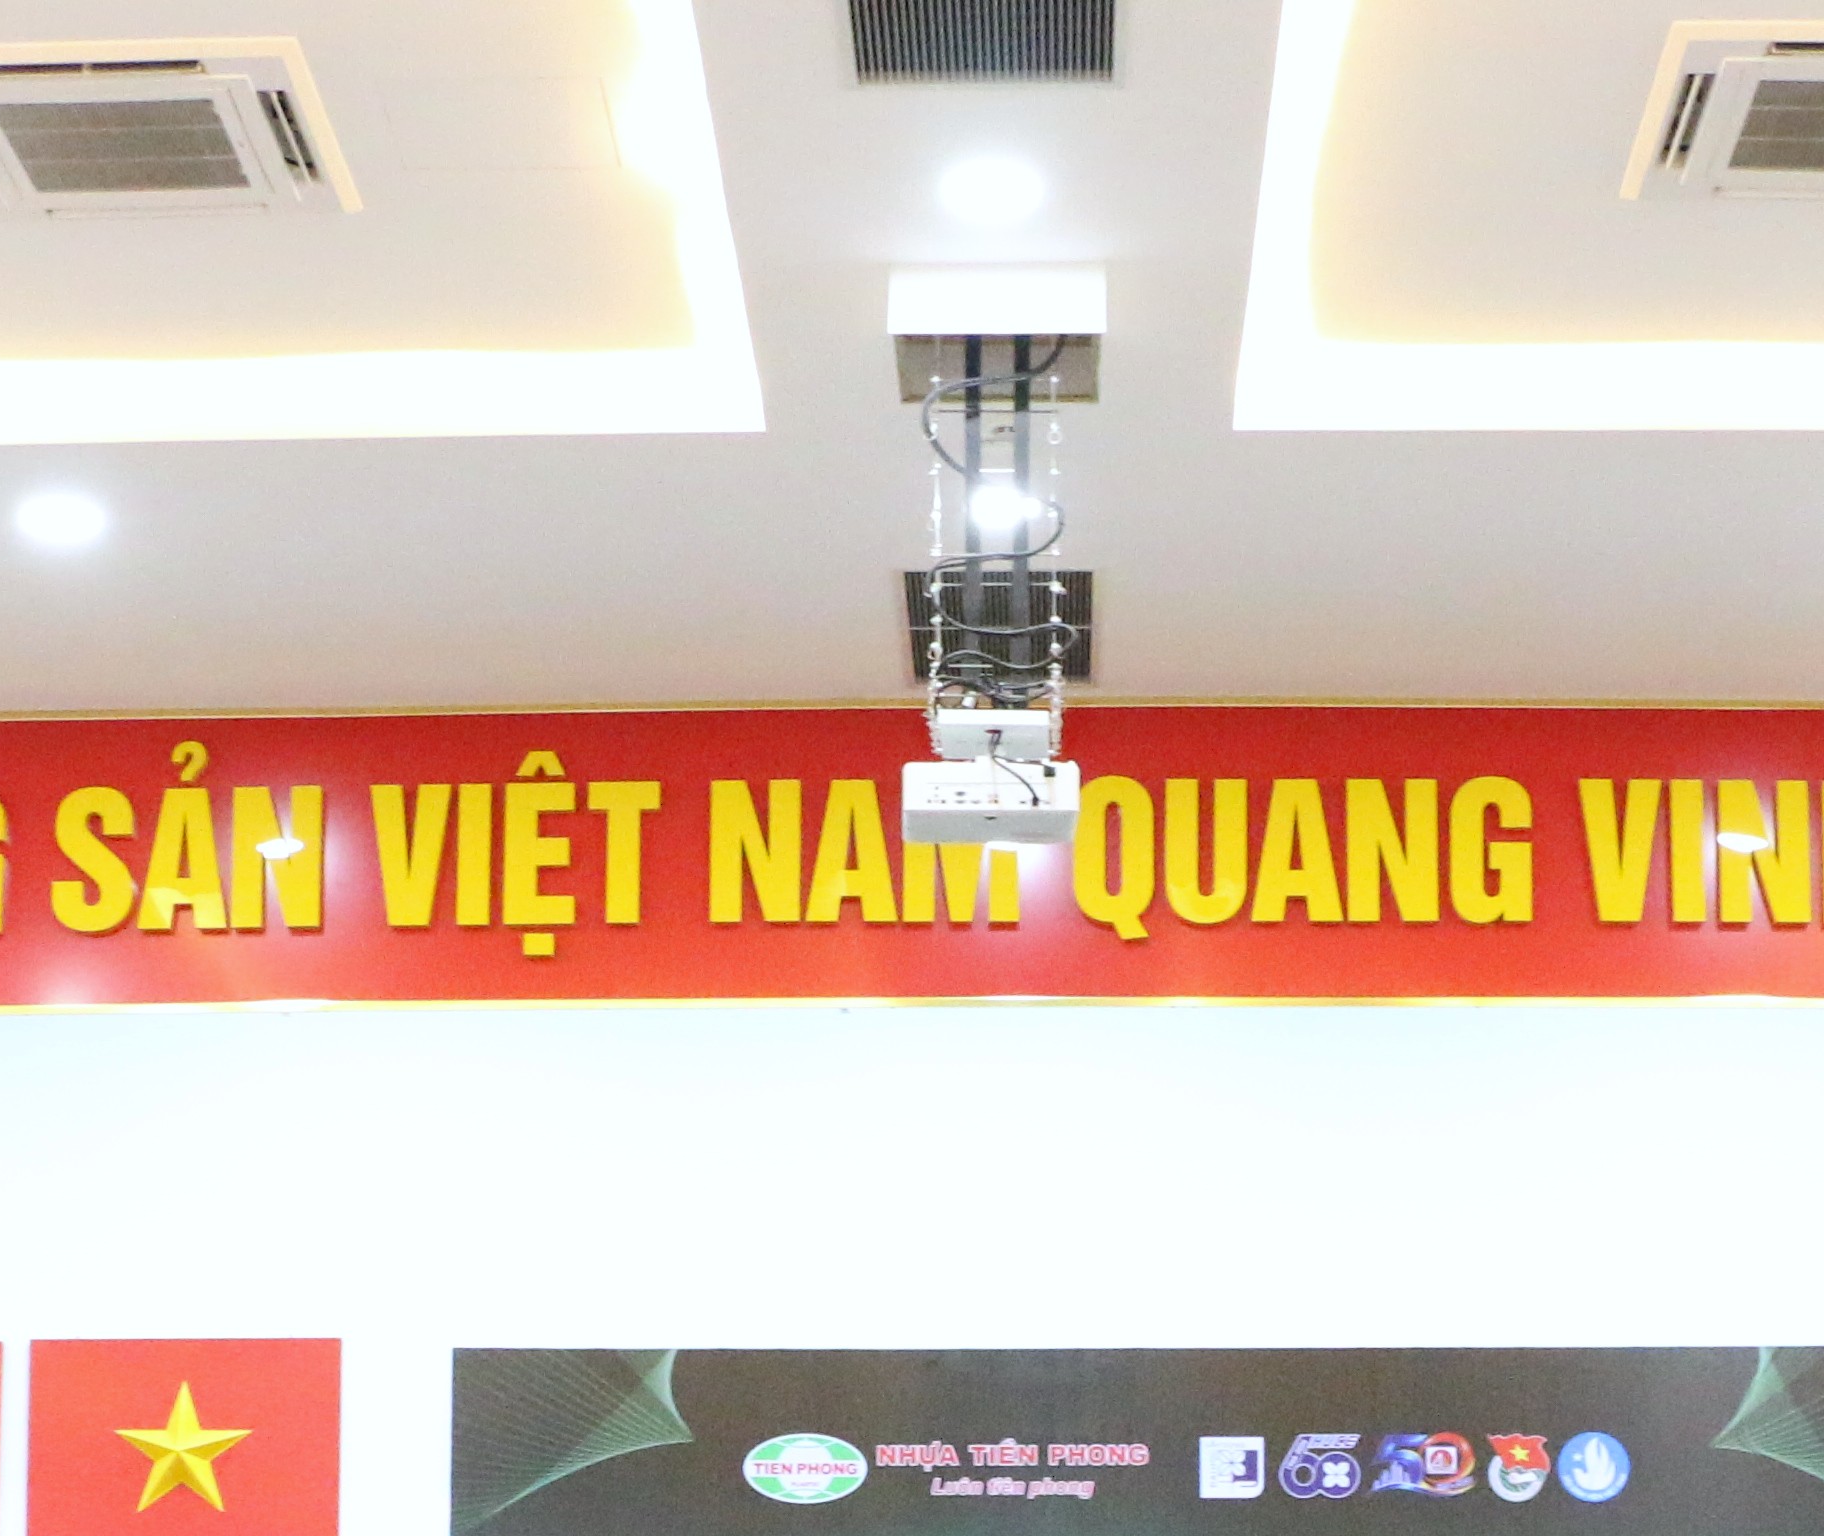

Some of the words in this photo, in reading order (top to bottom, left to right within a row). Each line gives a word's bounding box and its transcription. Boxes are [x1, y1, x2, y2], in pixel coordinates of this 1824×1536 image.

[51, 741, 323, 932] SẢN
[370, 749, 661, 956] VIỆT
[1073, 776, 1533, 939] QUANG
[797, 1463, 858, 1475] PHONG
[876, 1441, 960, 1472] NHỰA
[1047, 1444, 1150, 1467] PHONG
